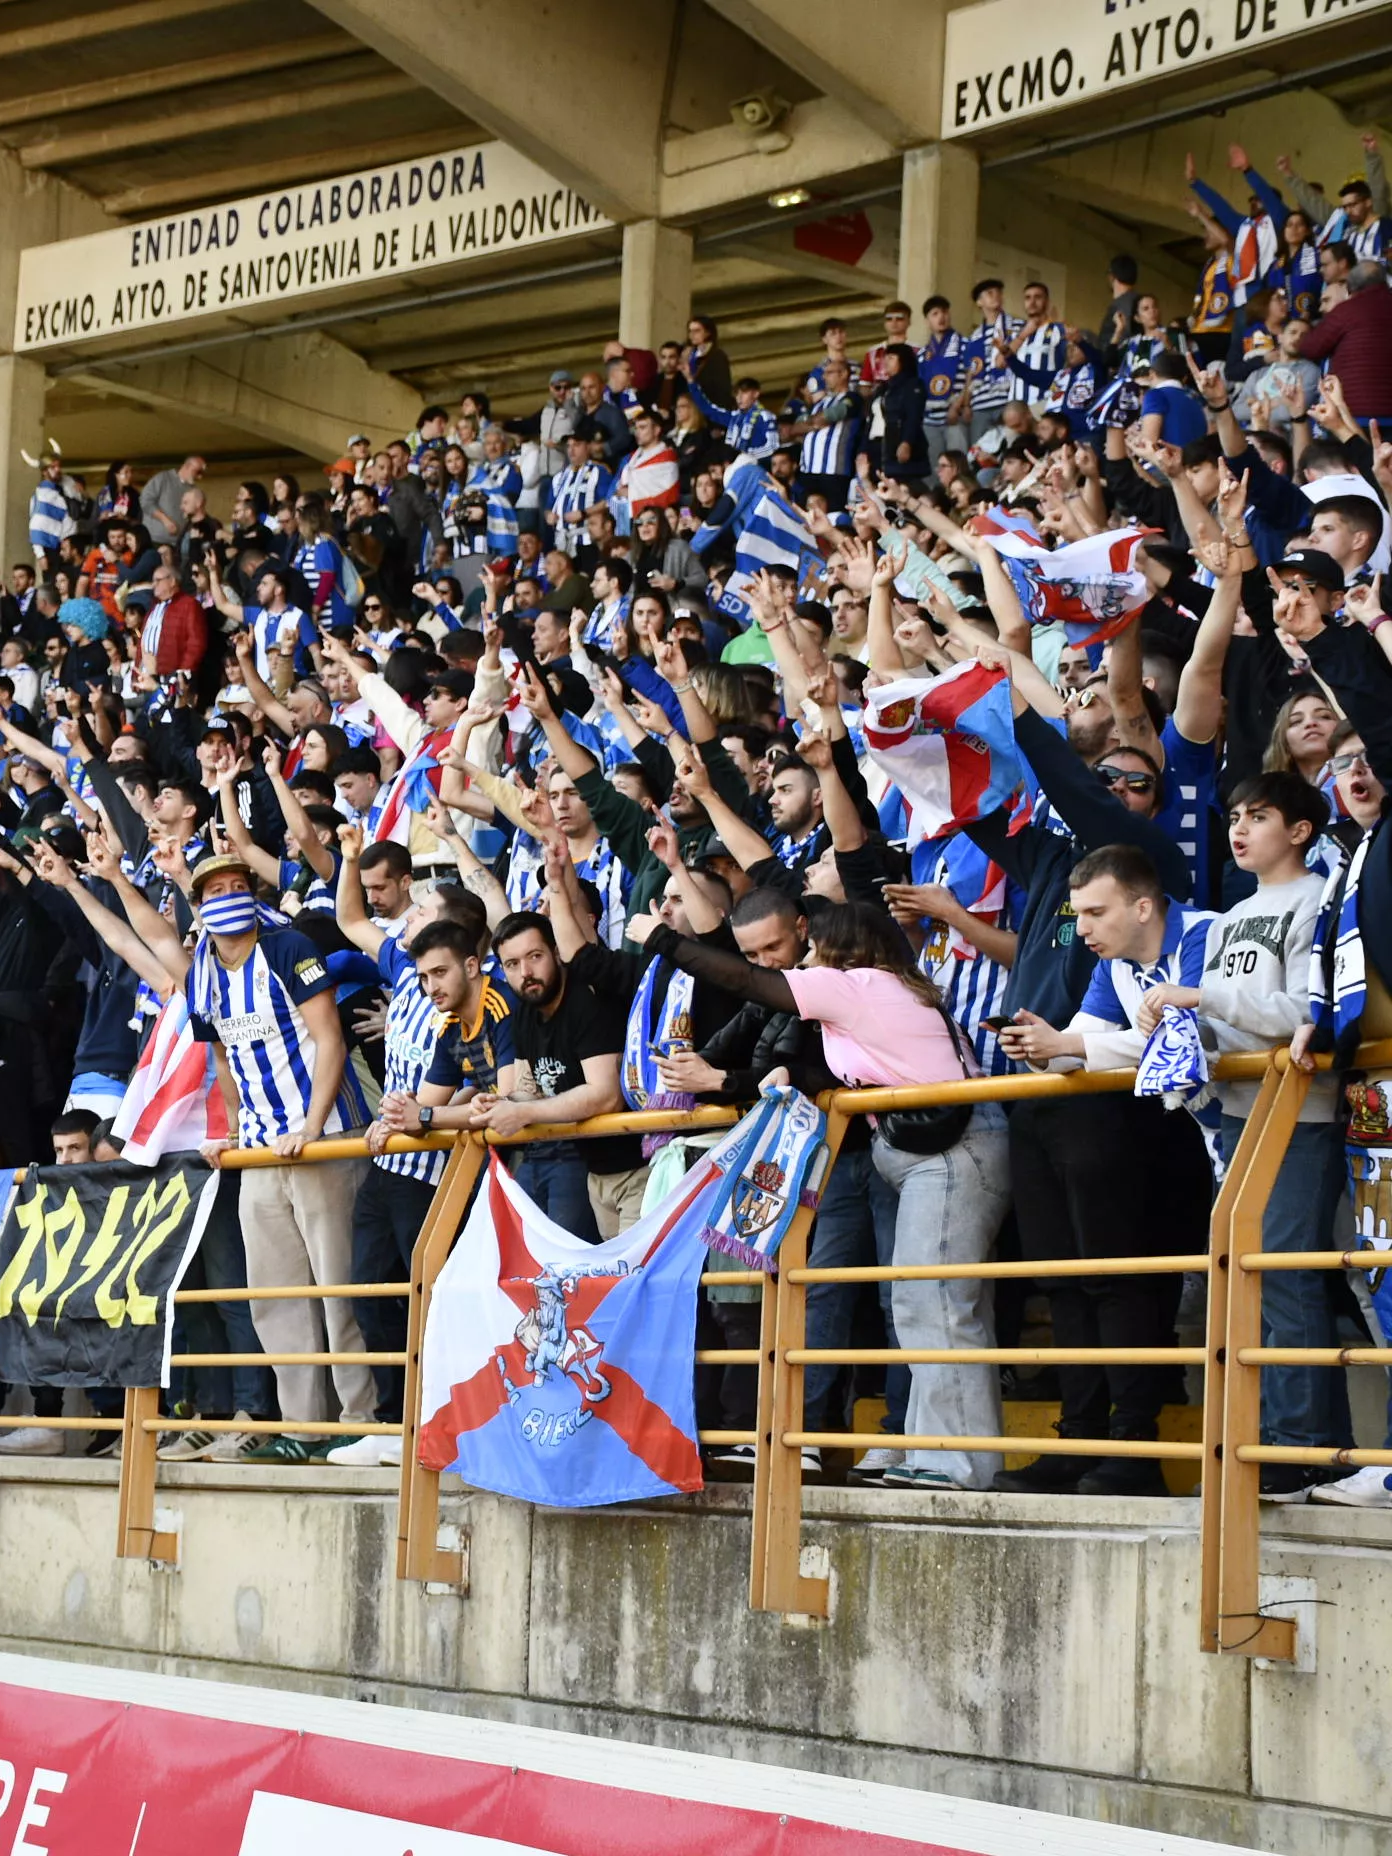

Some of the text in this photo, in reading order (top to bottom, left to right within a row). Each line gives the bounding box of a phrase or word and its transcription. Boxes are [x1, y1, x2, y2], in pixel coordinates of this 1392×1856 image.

[953, 0, 1277, 128] EXCMO. AYTO. DE
[130, 151, 485, 268] ENTIDAD COLABORADORA
[24, 298, 101, 343] EXCMO.
[111, 279, 172, 325] AYTO.
[184, 270, 208, 307] DE
[218, 238, 362, 303] SANTOVENIA
[372, 232, 399, 271] DE
[411, 221, 436, 261] LA
[1222, 949, 1258, 979] 1970
[219, 1014, 262, 1031] HERRERO
[220, 1025, 277, 1044] RIGANTINA
